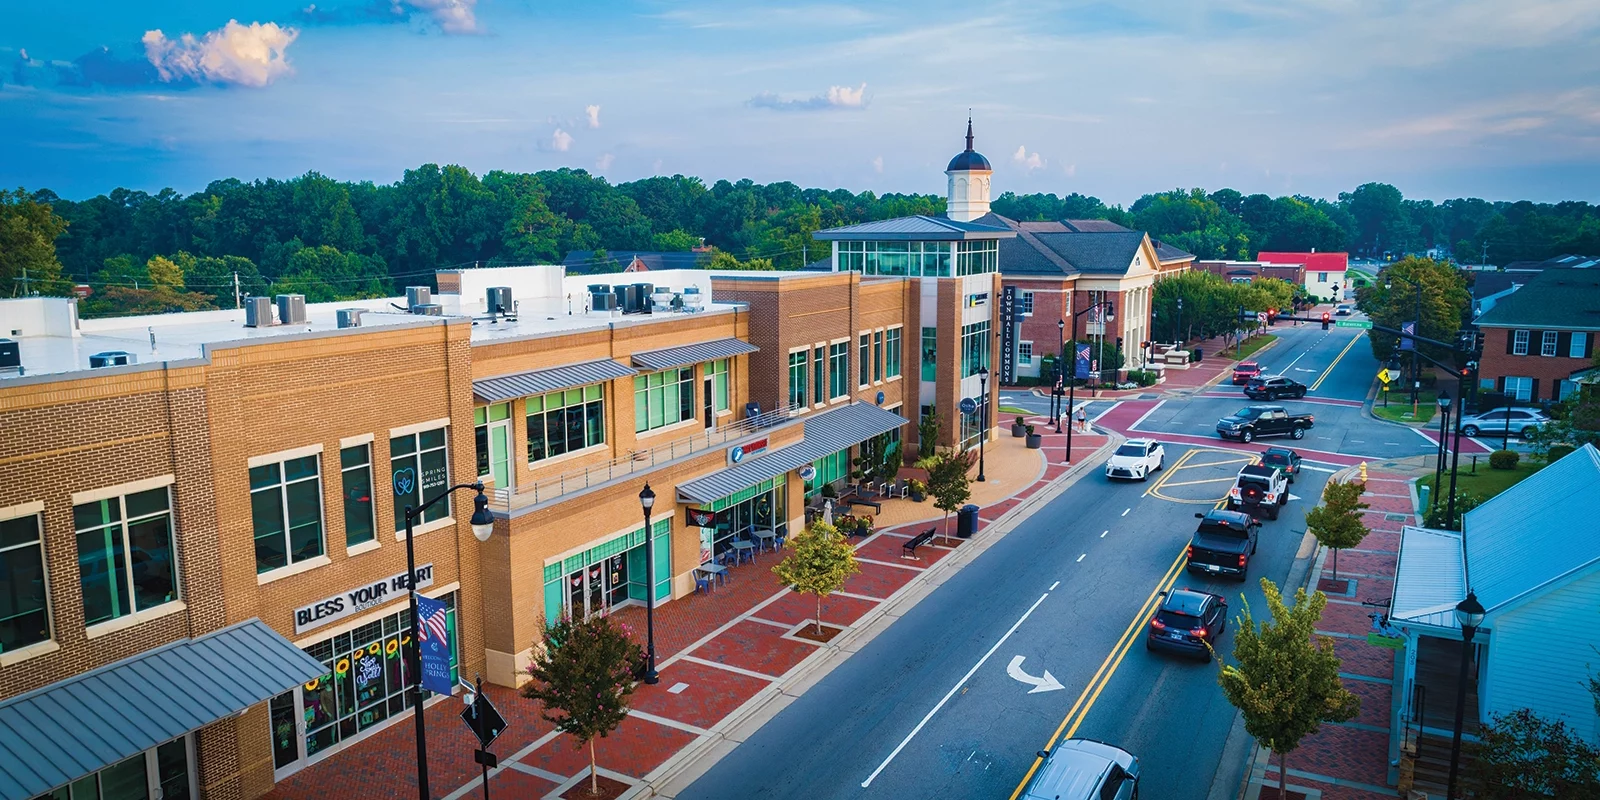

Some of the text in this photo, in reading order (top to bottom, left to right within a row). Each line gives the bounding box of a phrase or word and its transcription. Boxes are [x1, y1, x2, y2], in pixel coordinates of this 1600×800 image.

[421, 466, 446, 477] SPRING
[421, 473, 446, 485] SMILES
[297, 597, 345, 626] BLESS
[348, 582, 388, 606] YOUR
[354, 597, 384, 613] BOUTIQUE
[424, 662, 447, 671] HOLLY
